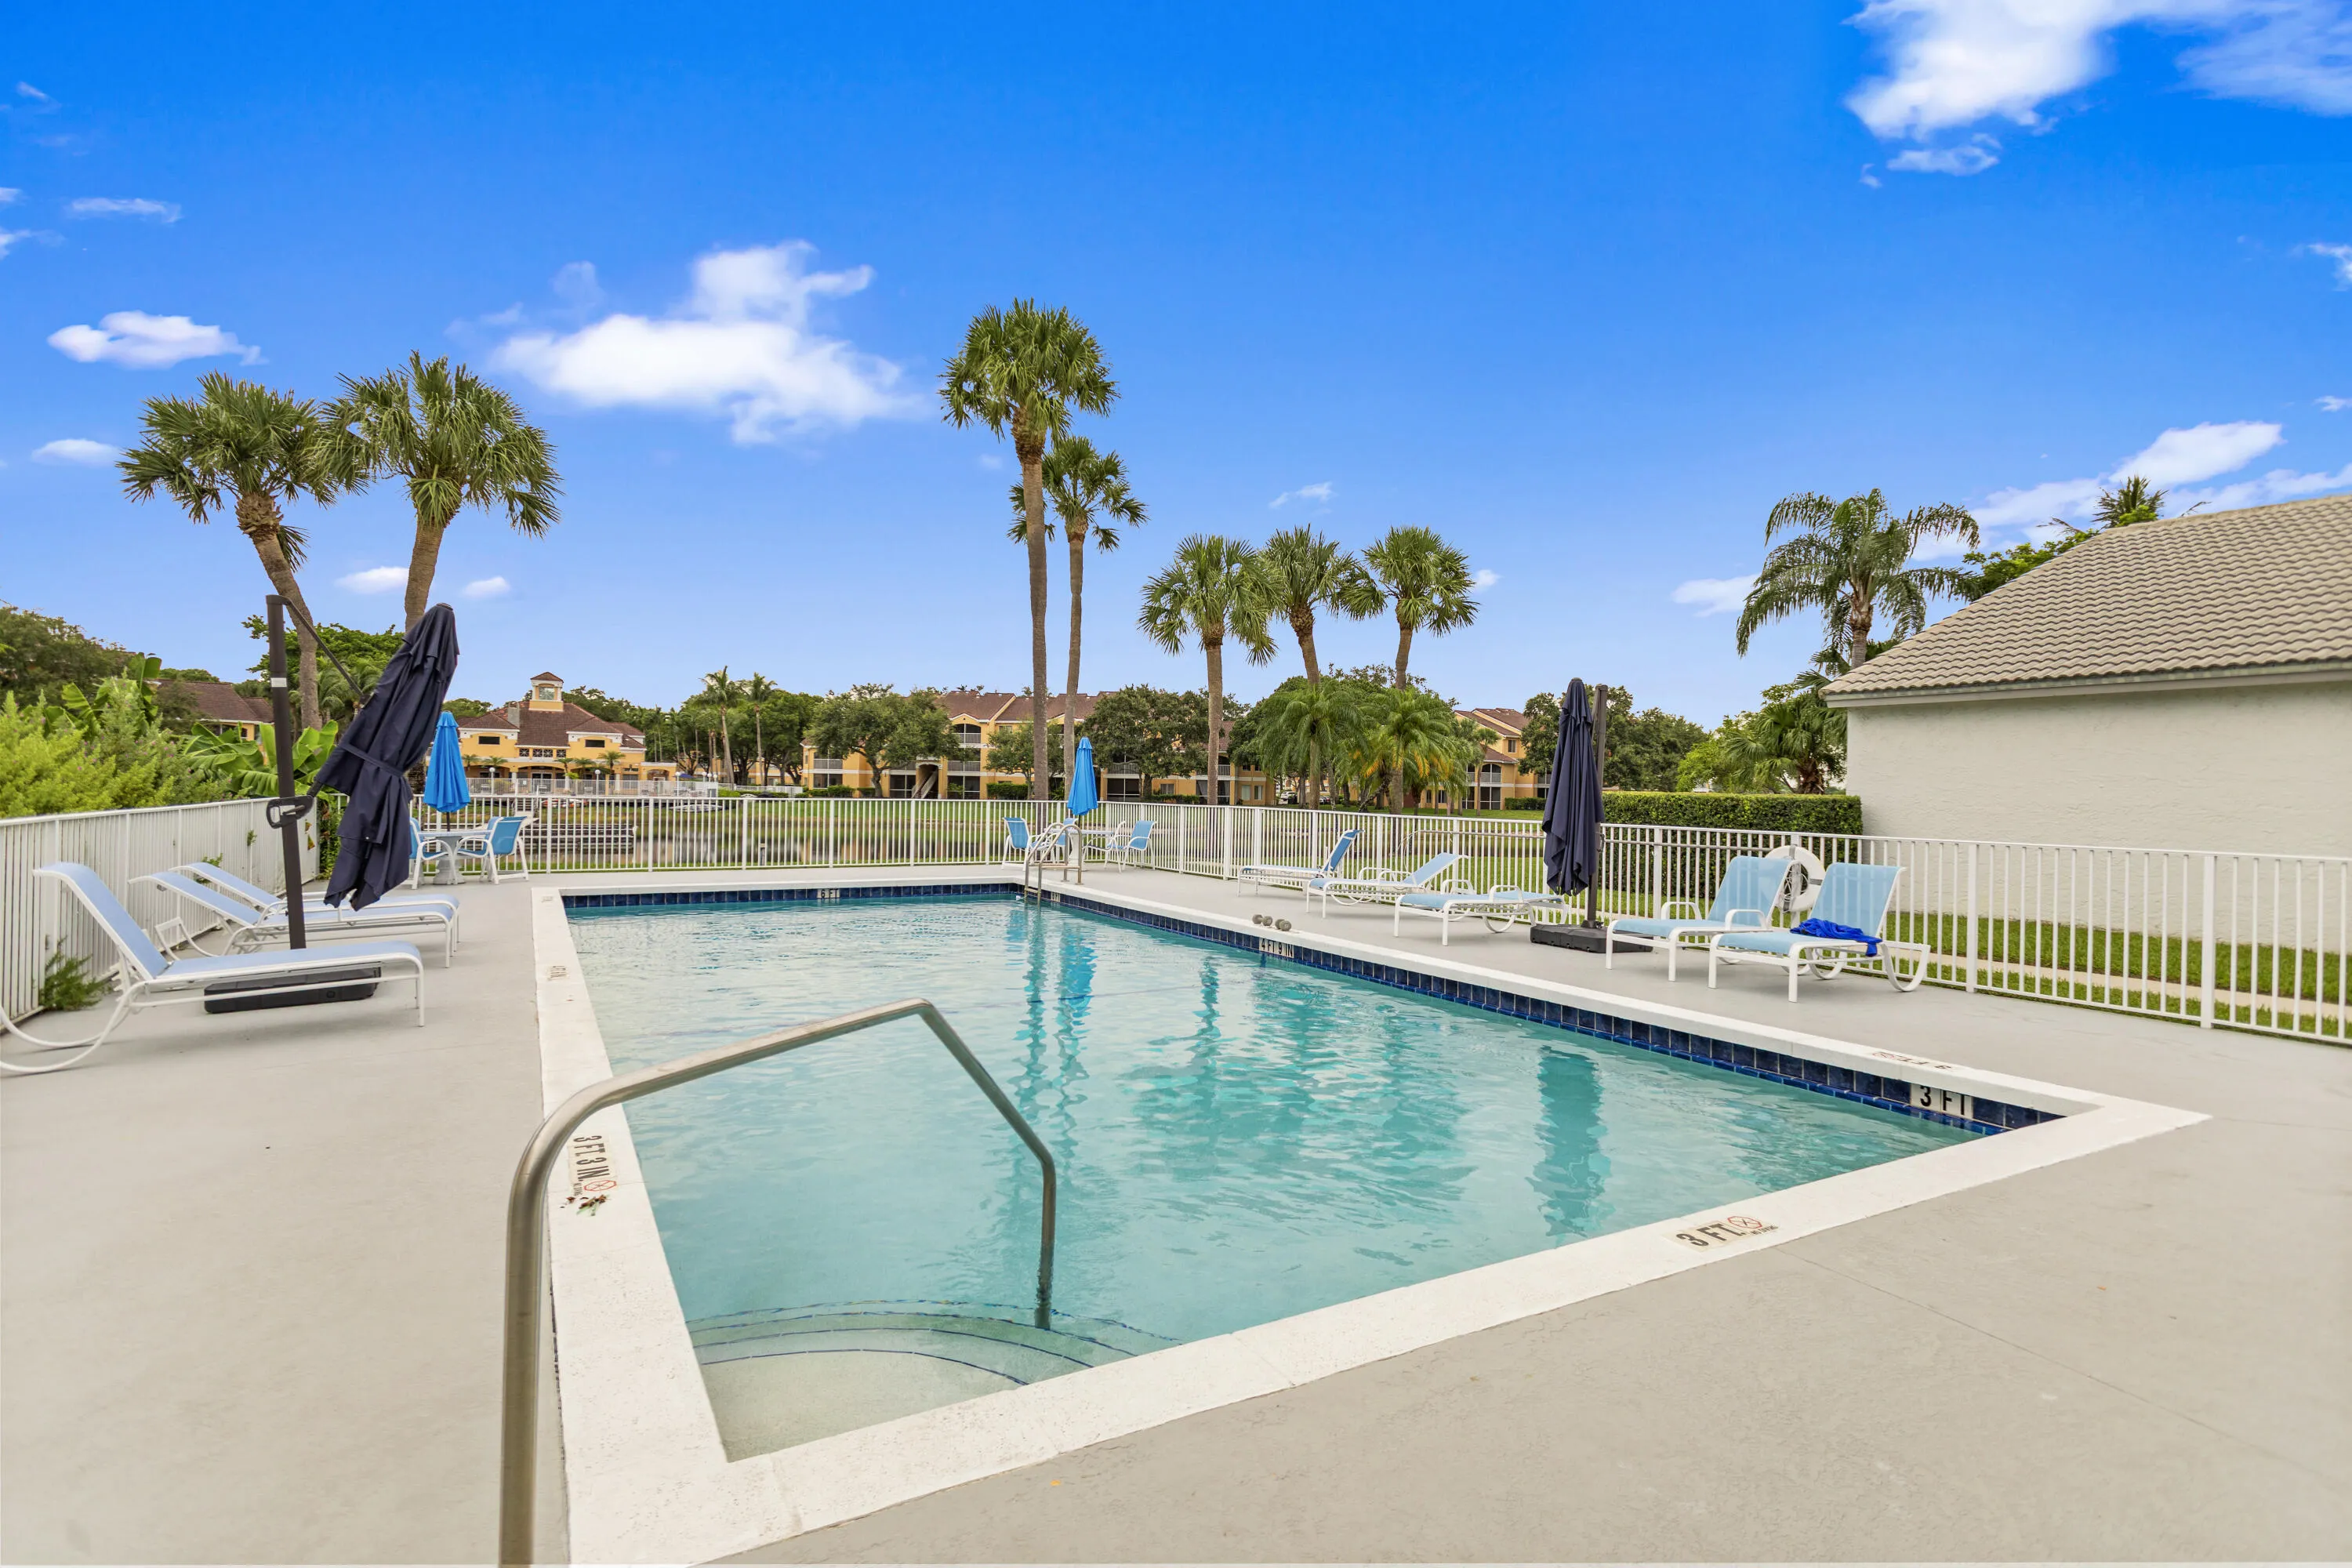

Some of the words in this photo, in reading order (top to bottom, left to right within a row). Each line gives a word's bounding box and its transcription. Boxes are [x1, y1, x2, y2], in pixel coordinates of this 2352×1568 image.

[821, 889, 826, 898] 6
[829, 888, 838, 898] FT
[1261, 938, 1265, 950] 4
[1268, 941, 1275, 953] FT
[1278, 942, 1283, 954] 9
[1285, 944, 1293, 956] IN
[1919, 1085, 1932, 1107] 3
[576, 1166, 610, 1181] IN.
[1675, 1233, 1709, 1247] 3
[1697, 1223, 1746, 1241] FT.
